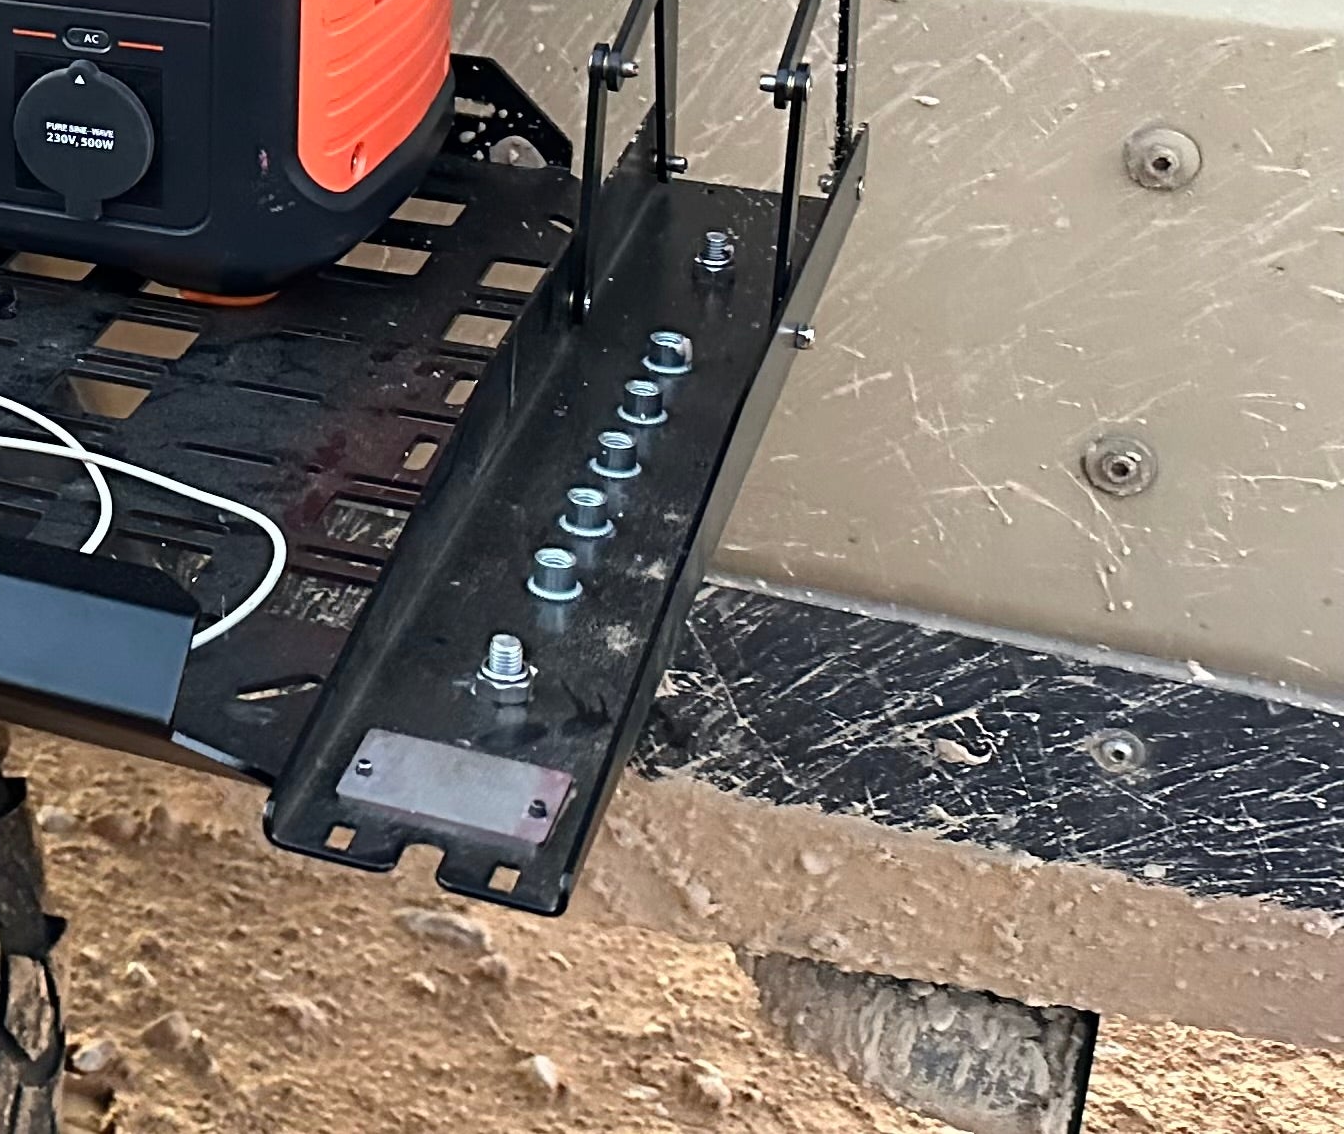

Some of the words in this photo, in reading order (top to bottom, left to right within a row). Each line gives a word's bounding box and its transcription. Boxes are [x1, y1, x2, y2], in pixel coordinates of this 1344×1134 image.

[83, 34, 99, 44] AC
[46, 121, 68, 132] PURE
[80, 137, 114, 150] 500W
